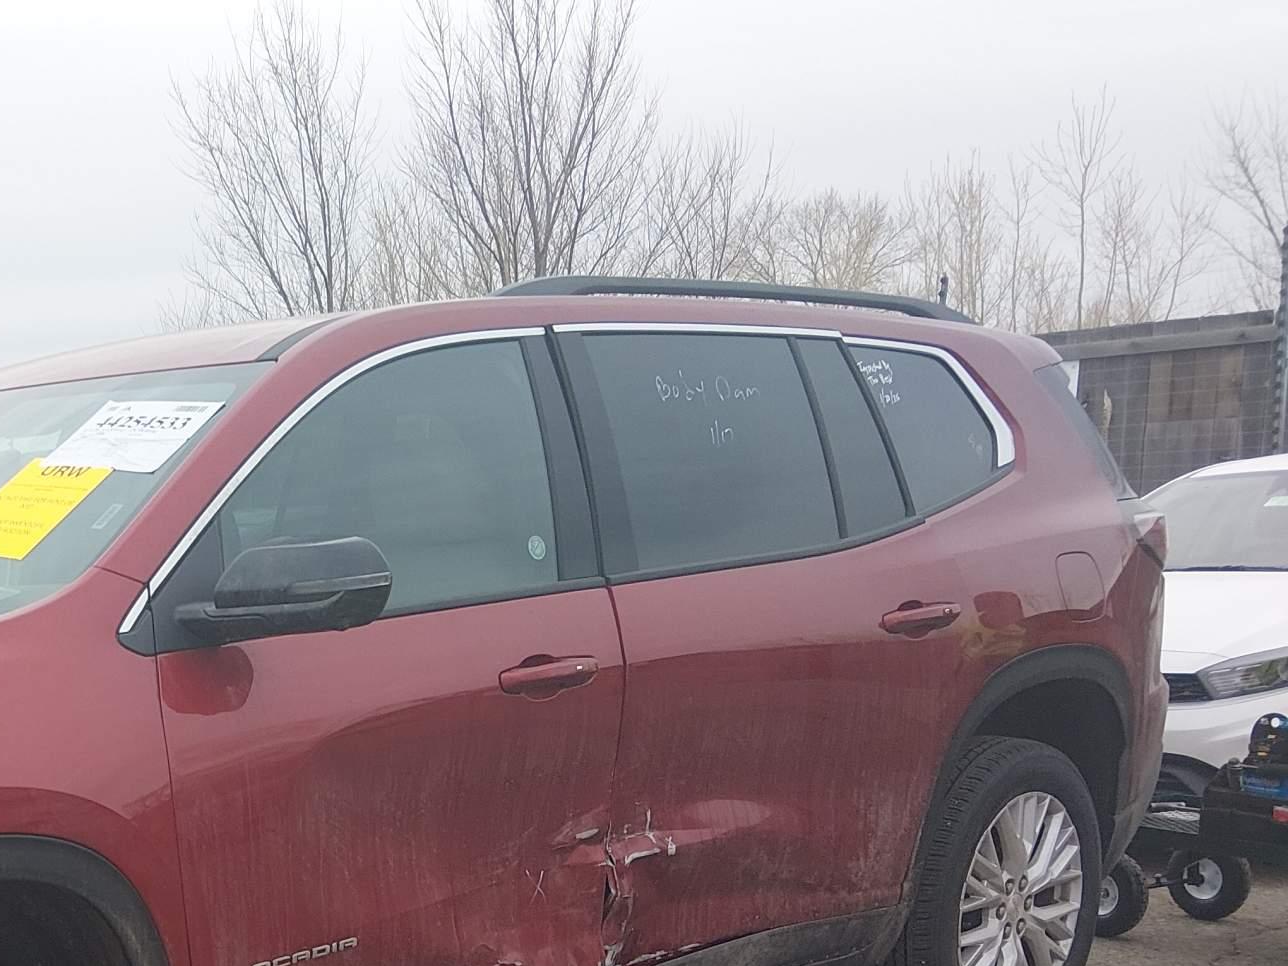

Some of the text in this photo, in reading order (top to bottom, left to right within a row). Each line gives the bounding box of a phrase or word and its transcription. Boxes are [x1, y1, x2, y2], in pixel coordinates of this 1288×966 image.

[715, 375, 761, 401] Dam
[96, 415, 192, 430] 44254533
[41, 465, 92, 478] URW
